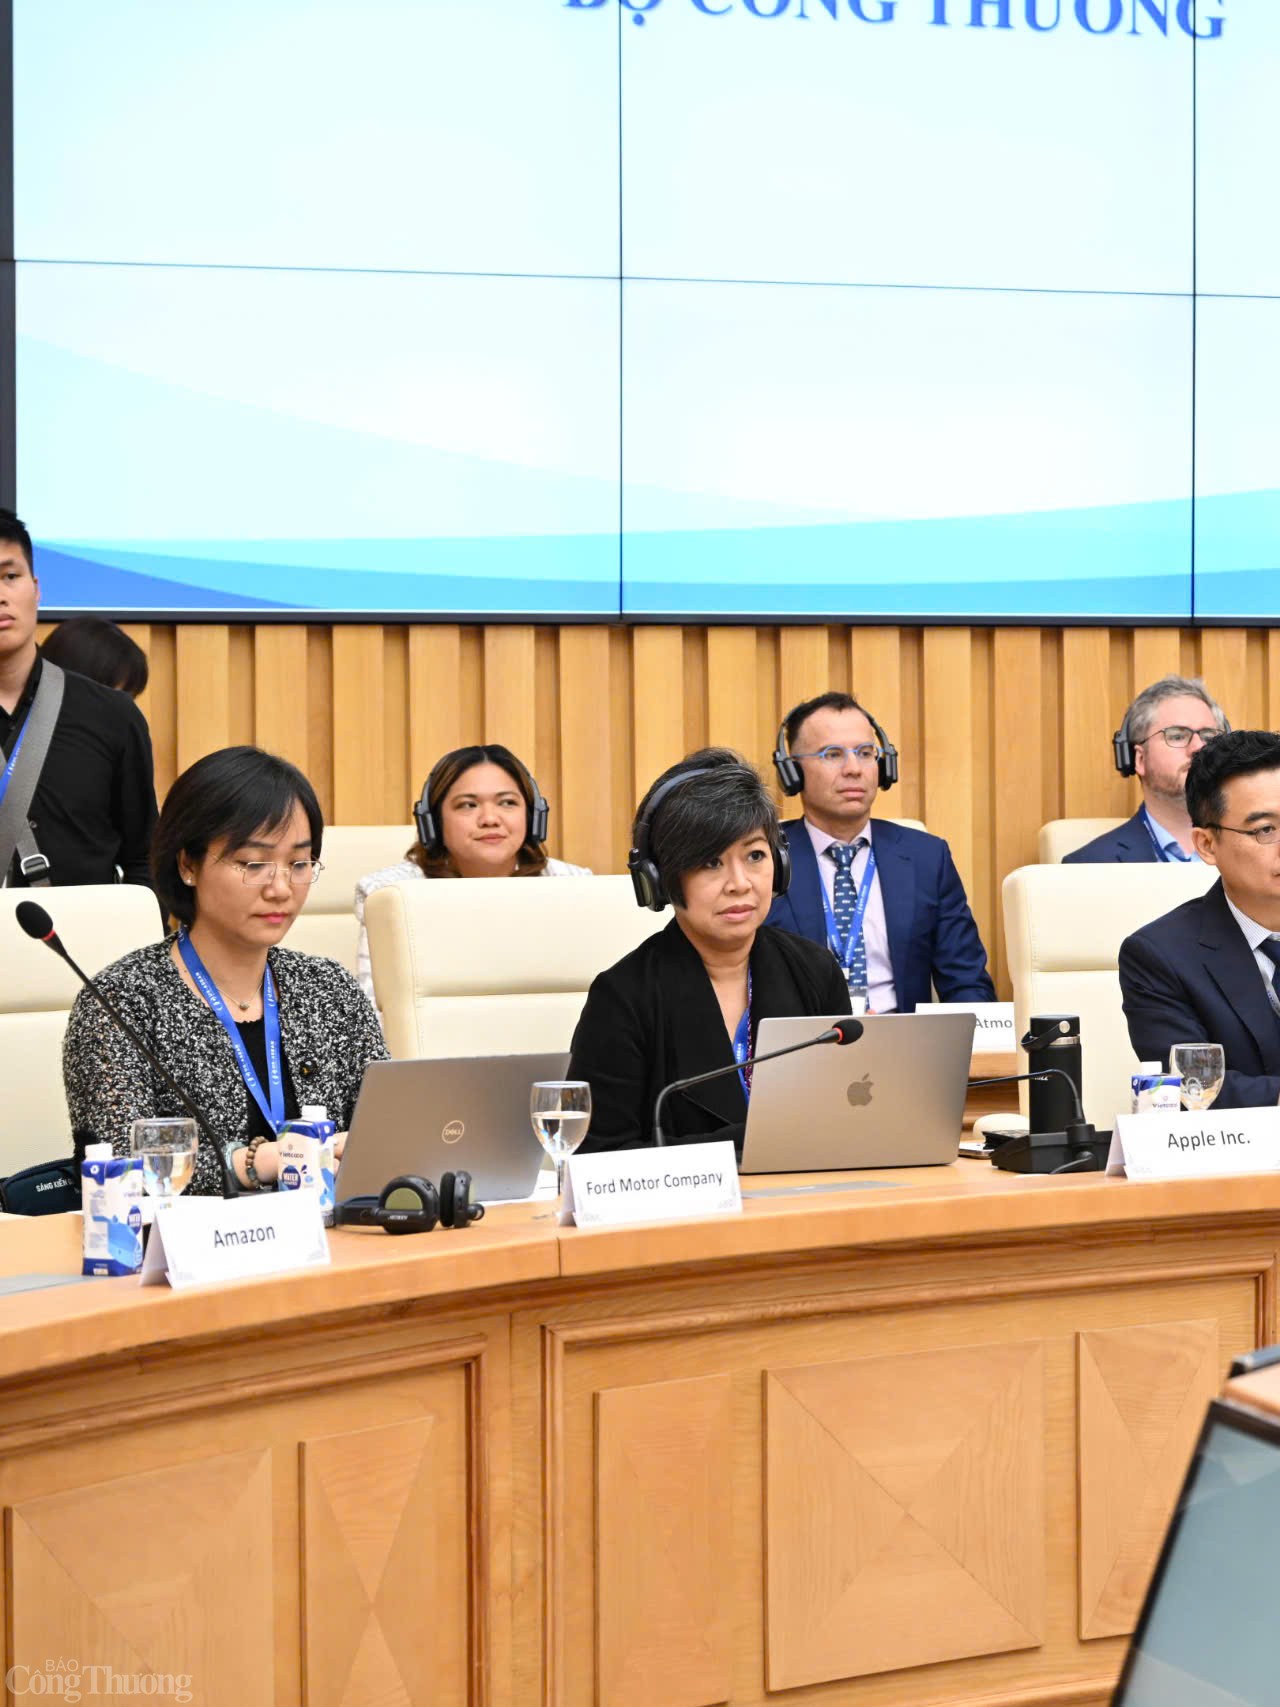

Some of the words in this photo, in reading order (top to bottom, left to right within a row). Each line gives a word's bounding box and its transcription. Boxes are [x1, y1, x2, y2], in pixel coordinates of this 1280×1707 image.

[1168, 1130, 1216, 1151] Apple
[1220, 1130, 1251, 1145] Inc.
[35, 1182, 54, 1192] SÁNG
[53, 1177, 68, 1188] KIẾN
[586, 1179, 616, 1195] Ford
[619, 1177, 660, 1193] Motor
[664, 1172, 723, 1189] Company
[214, 1226, 276, 1248] Amazon
